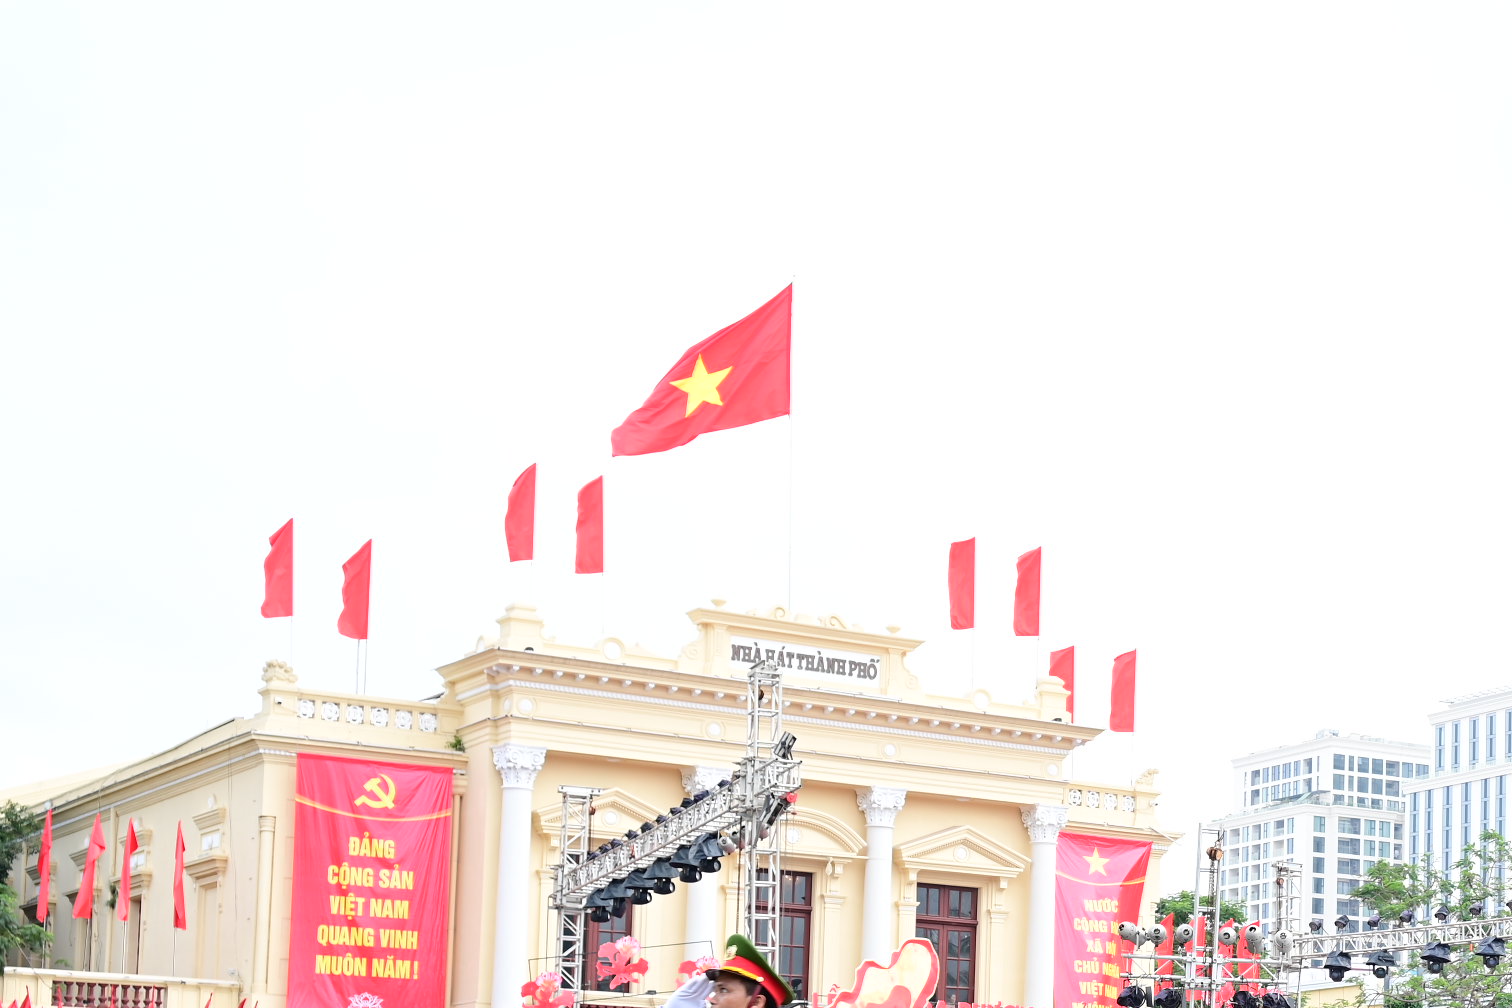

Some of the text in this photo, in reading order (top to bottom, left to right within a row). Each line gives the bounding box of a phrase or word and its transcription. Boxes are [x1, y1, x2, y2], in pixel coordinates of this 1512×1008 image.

[731, 642, 880, 681] NHÀ HÁT THÀNH PHỐ
[348, 832, 396, 859] ĐẢNG
[327, 862, 414, 890] CỘNG SẢN
[330, 892, 409, 920] VIỆT NAM
[1085, 897, 1119, 913] NƯỚC
[317, 925, 418, 949] QUANG VINH
[1073, 917, 1108, 935] CỘNG
[1087, 939, 1103, 954] XÃ
[315, 953, 367, 977] MUÔN
[1074, 957, 1100, 974] CHỦ
[1079, 980, 1103, 998] VIỆT
